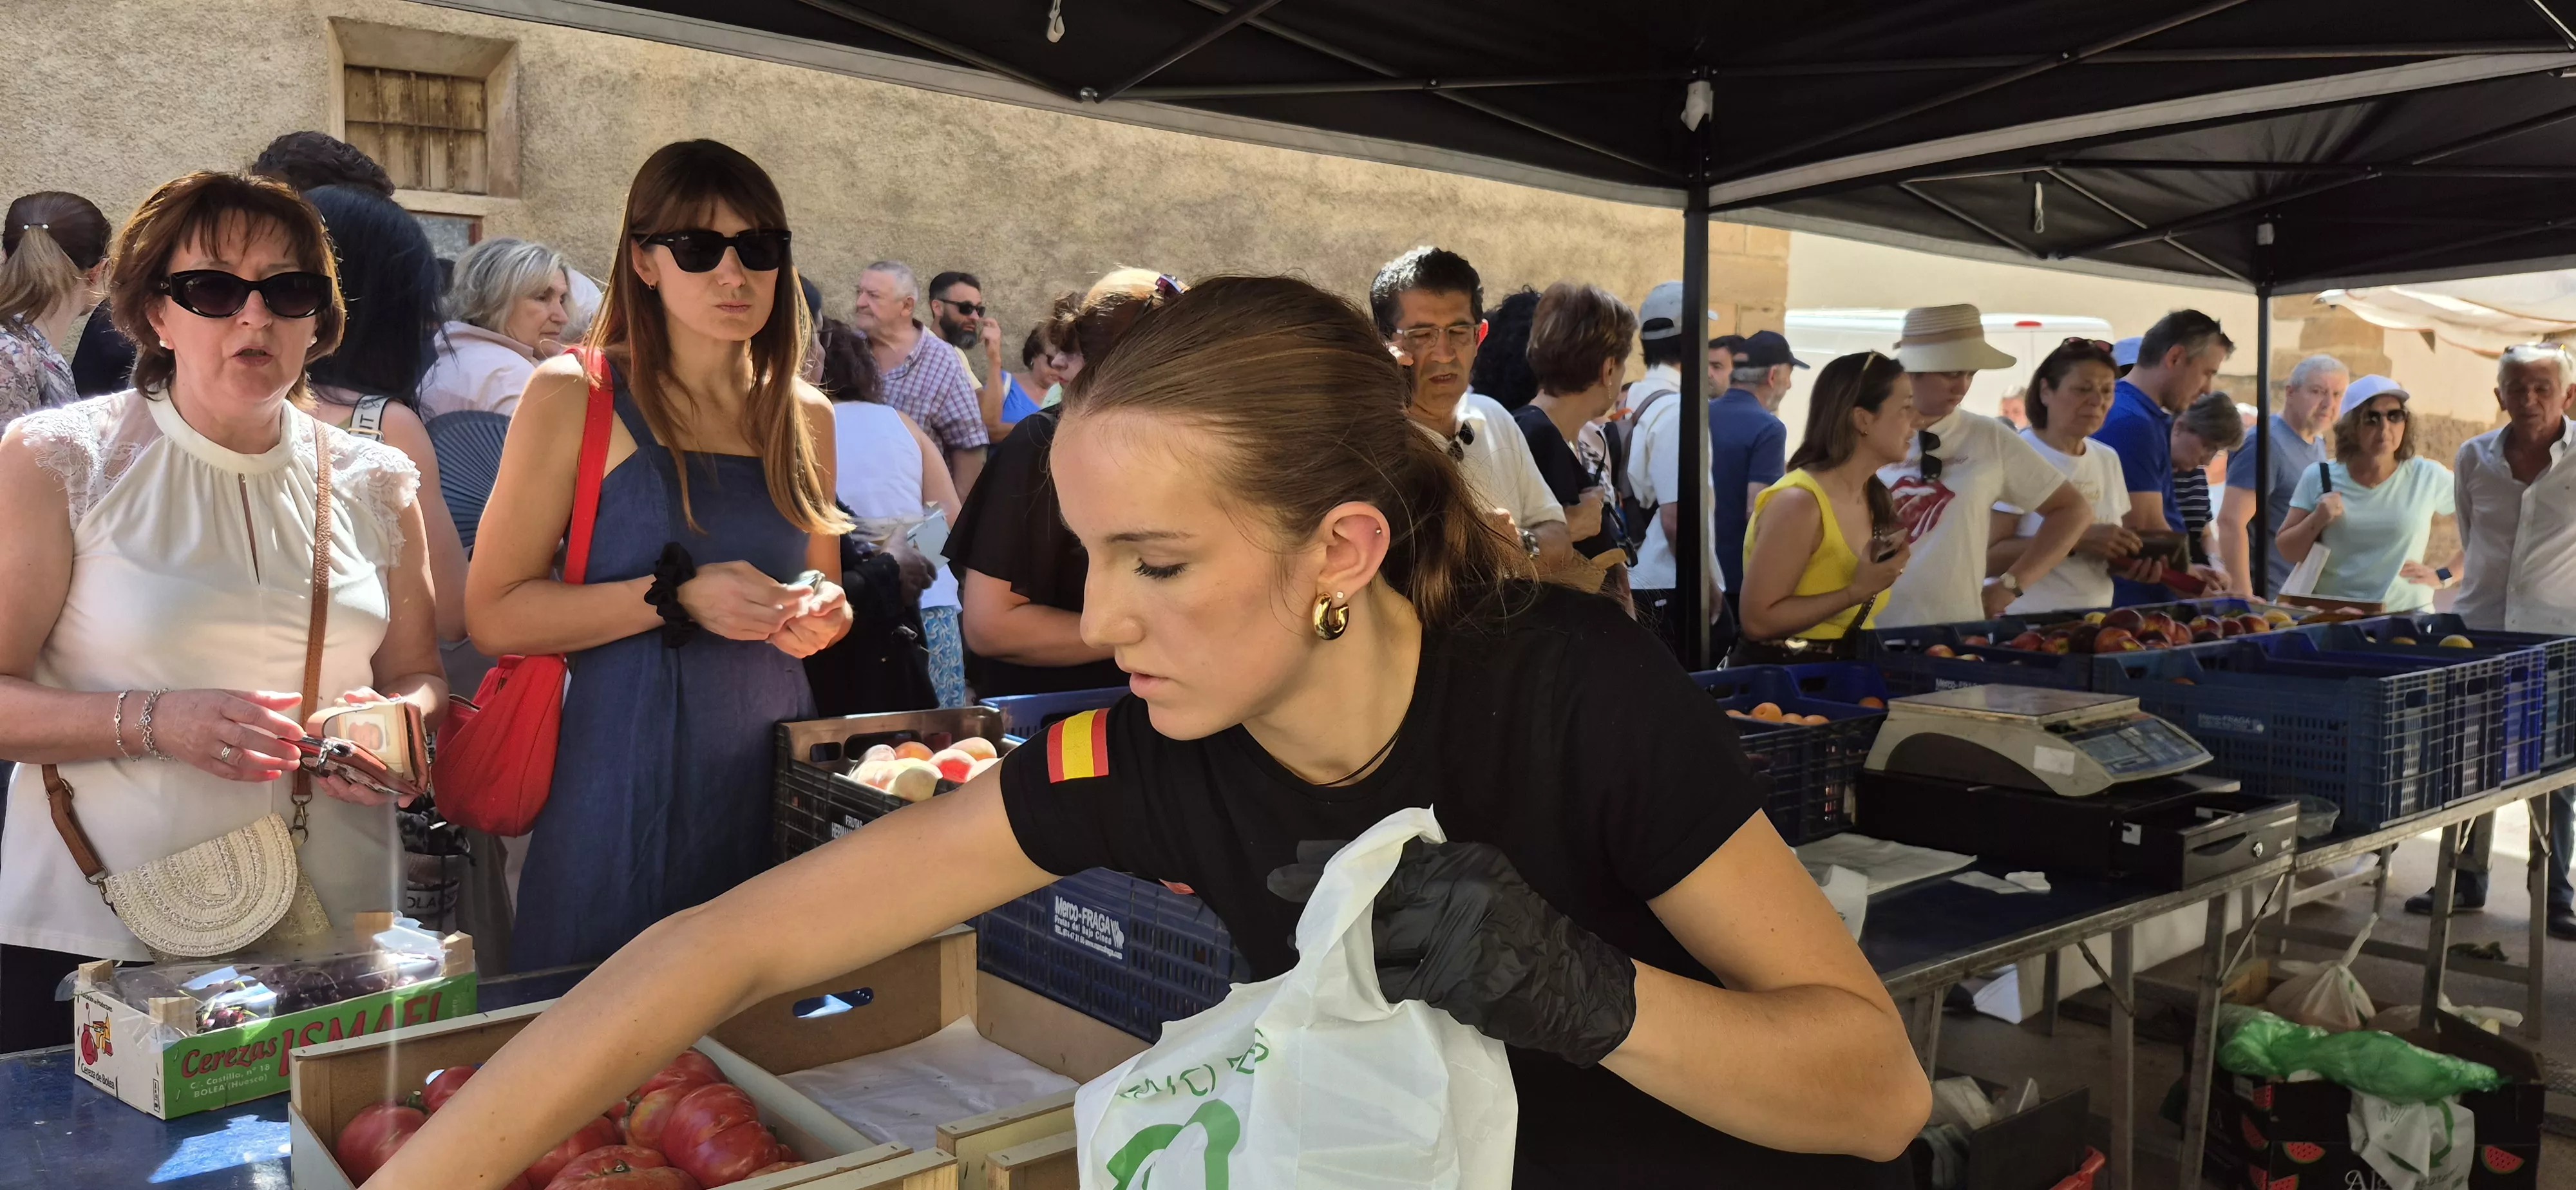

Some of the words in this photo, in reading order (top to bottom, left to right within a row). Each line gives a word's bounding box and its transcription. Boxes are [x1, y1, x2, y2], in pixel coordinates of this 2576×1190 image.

[846, 814, 863, 829] FRUTAS
[1055, 895, 1110, 936] Merco-FRAGA
[1082, 926, 1094, 938] Bajo
[182, 1037, 278, 1077] Cerezas
[81, 1063, 95, 1079] Cereza
[96, 1072, 102, 1082] de
[102, 1073, 115, 1089] Bolea
[194, 1084, 225, 1098] BOLEA
[228, 1074, 268, 1091] (Huesca)
[207, 1071, 244, 1085] Castillo,
[260, 1064, 270, 1072] 18
